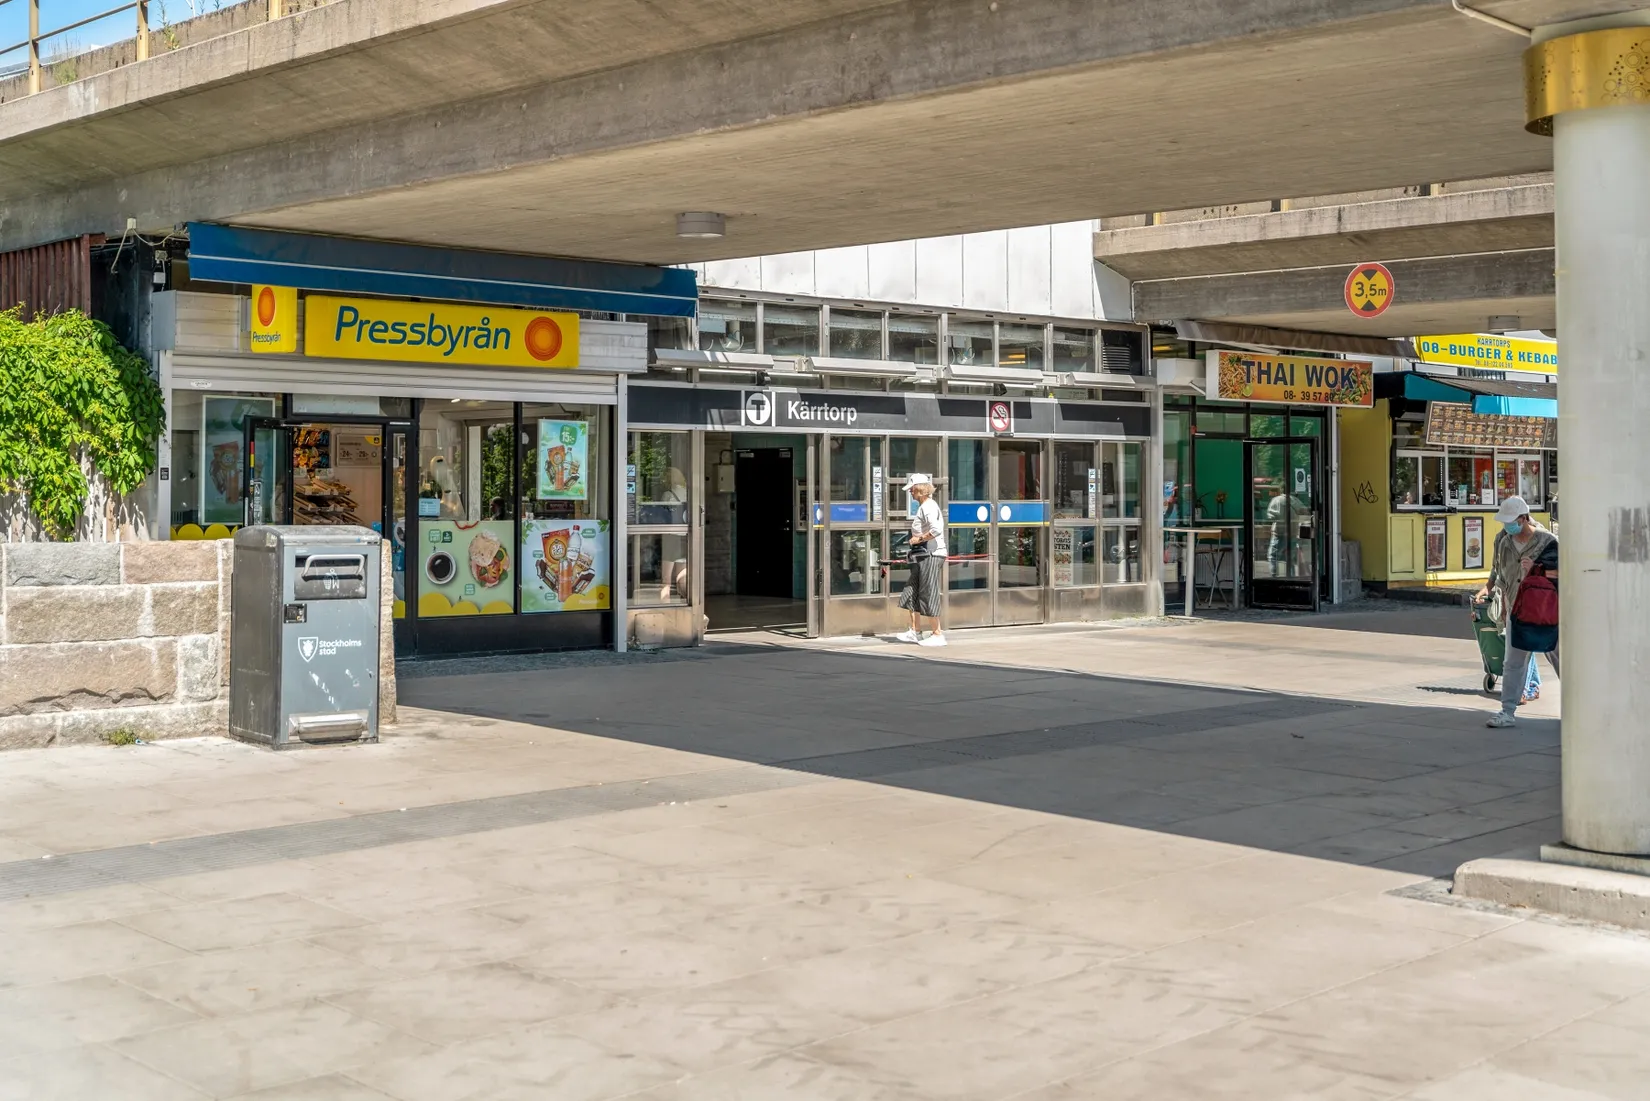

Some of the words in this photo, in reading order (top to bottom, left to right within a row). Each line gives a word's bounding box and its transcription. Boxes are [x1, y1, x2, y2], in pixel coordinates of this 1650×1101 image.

[1354, 281, 1387, 299] 3,5m
[252, 331, 281, 345] Pressbyrån
[334, 304, 511, 357] Pressbyrån
[1505, 349, 1513, 361] &
[1518, 351, 1558, 365] KEBAB
[1241, 360, 1295, 386] THAI
[1304, 364, 1356, 390] WOK
[1300, 391, 1310, 401] 39
[1312, 392, 1322, 402] 57
[787, 400, 858, 425] Kärrtorp
[319, 639, 362, 648] Stockholms
[319, 647, 337, 656] stad
